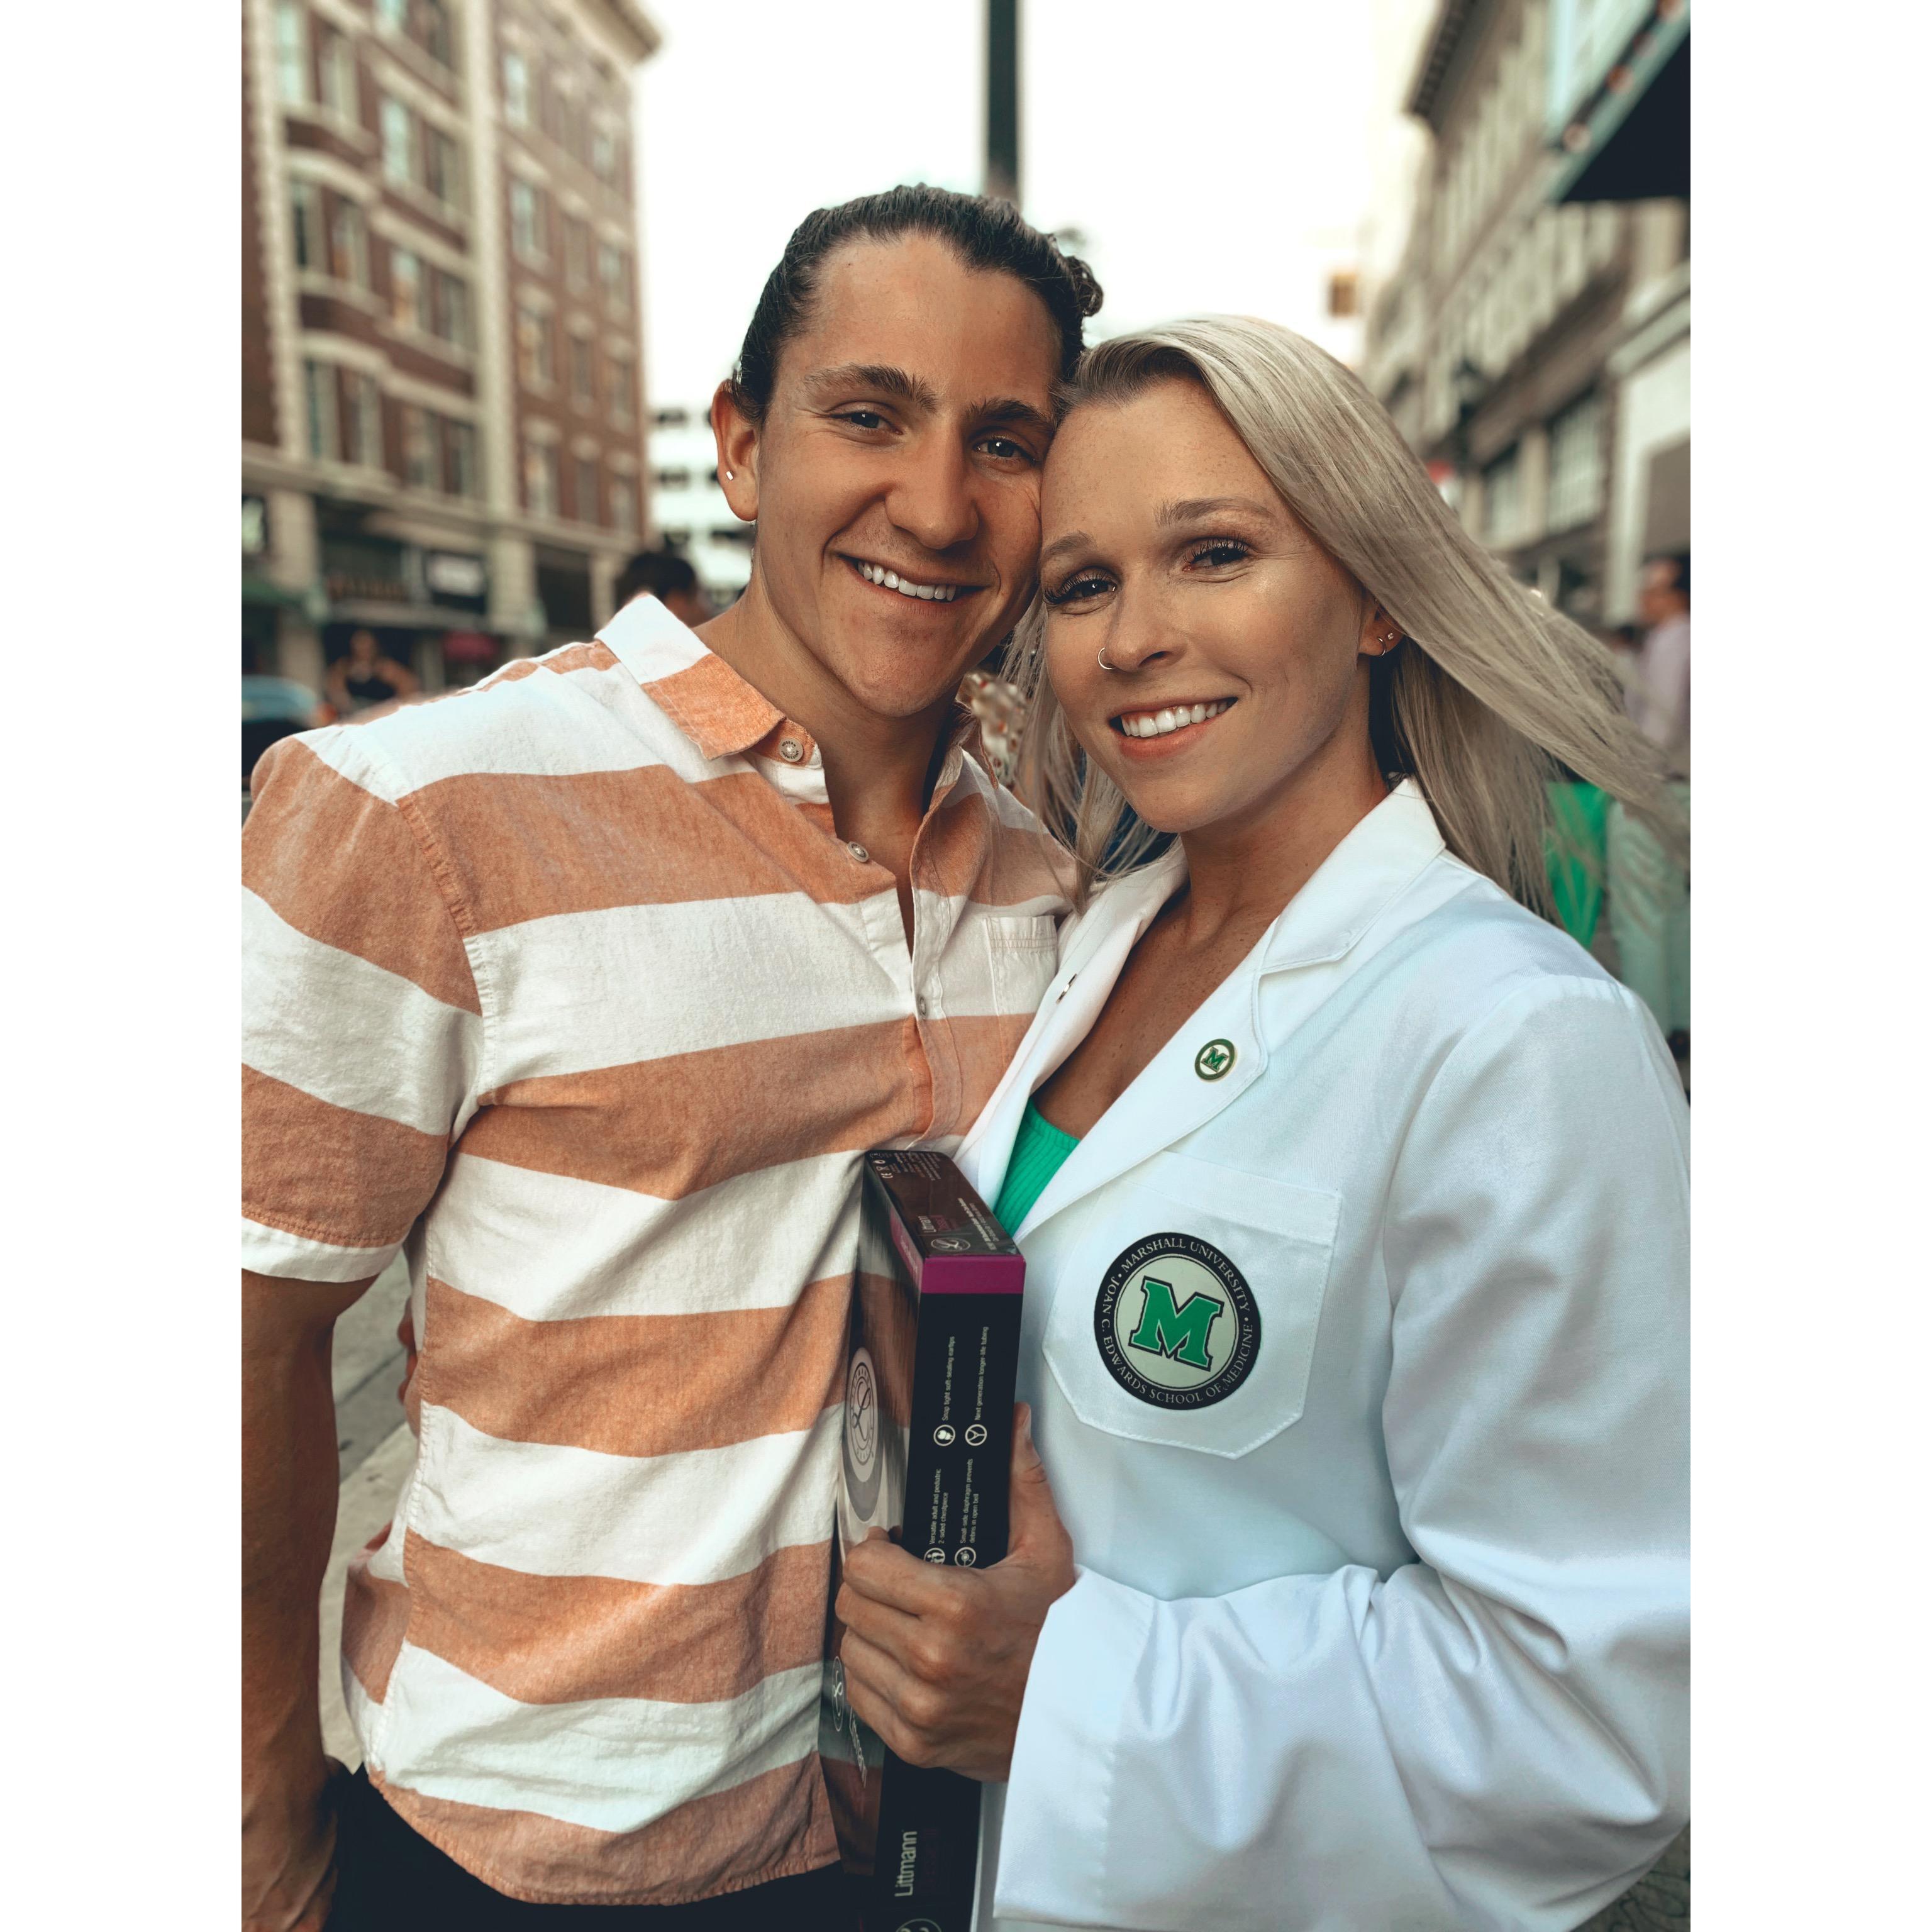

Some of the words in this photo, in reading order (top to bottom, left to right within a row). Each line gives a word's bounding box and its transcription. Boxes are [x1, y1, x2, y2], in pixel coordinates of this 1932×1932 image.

[1201, 1046, 1229, 1073] M
[1121, 1238, 1186, 1273] MARSHALL
[1190, 1241, 1250, 1313] UNIVERSITY
[1102, 1275, 1120, 1314] JOAN
[981, 1326, 989, 1345] tubing
[1102, 1318, 1111, 1332] C.
[1128, 1275, 1224, 1372] M
[1103, 1336, 1147, 1394] EDWARDS
[1223, 1325, 1253, 1388] MEDICINE
[945, 1357, 954, 1391] soft-sealing
[1150, 1389, 1203, 1404] SCHOOL
[1206, 1385, 1223, 1398] OF
[942, 1406, 950, 1421] Snap
[963, 1484, 972, 1513] diaphragm
[894, 1830, 918, 1897] Littmann
